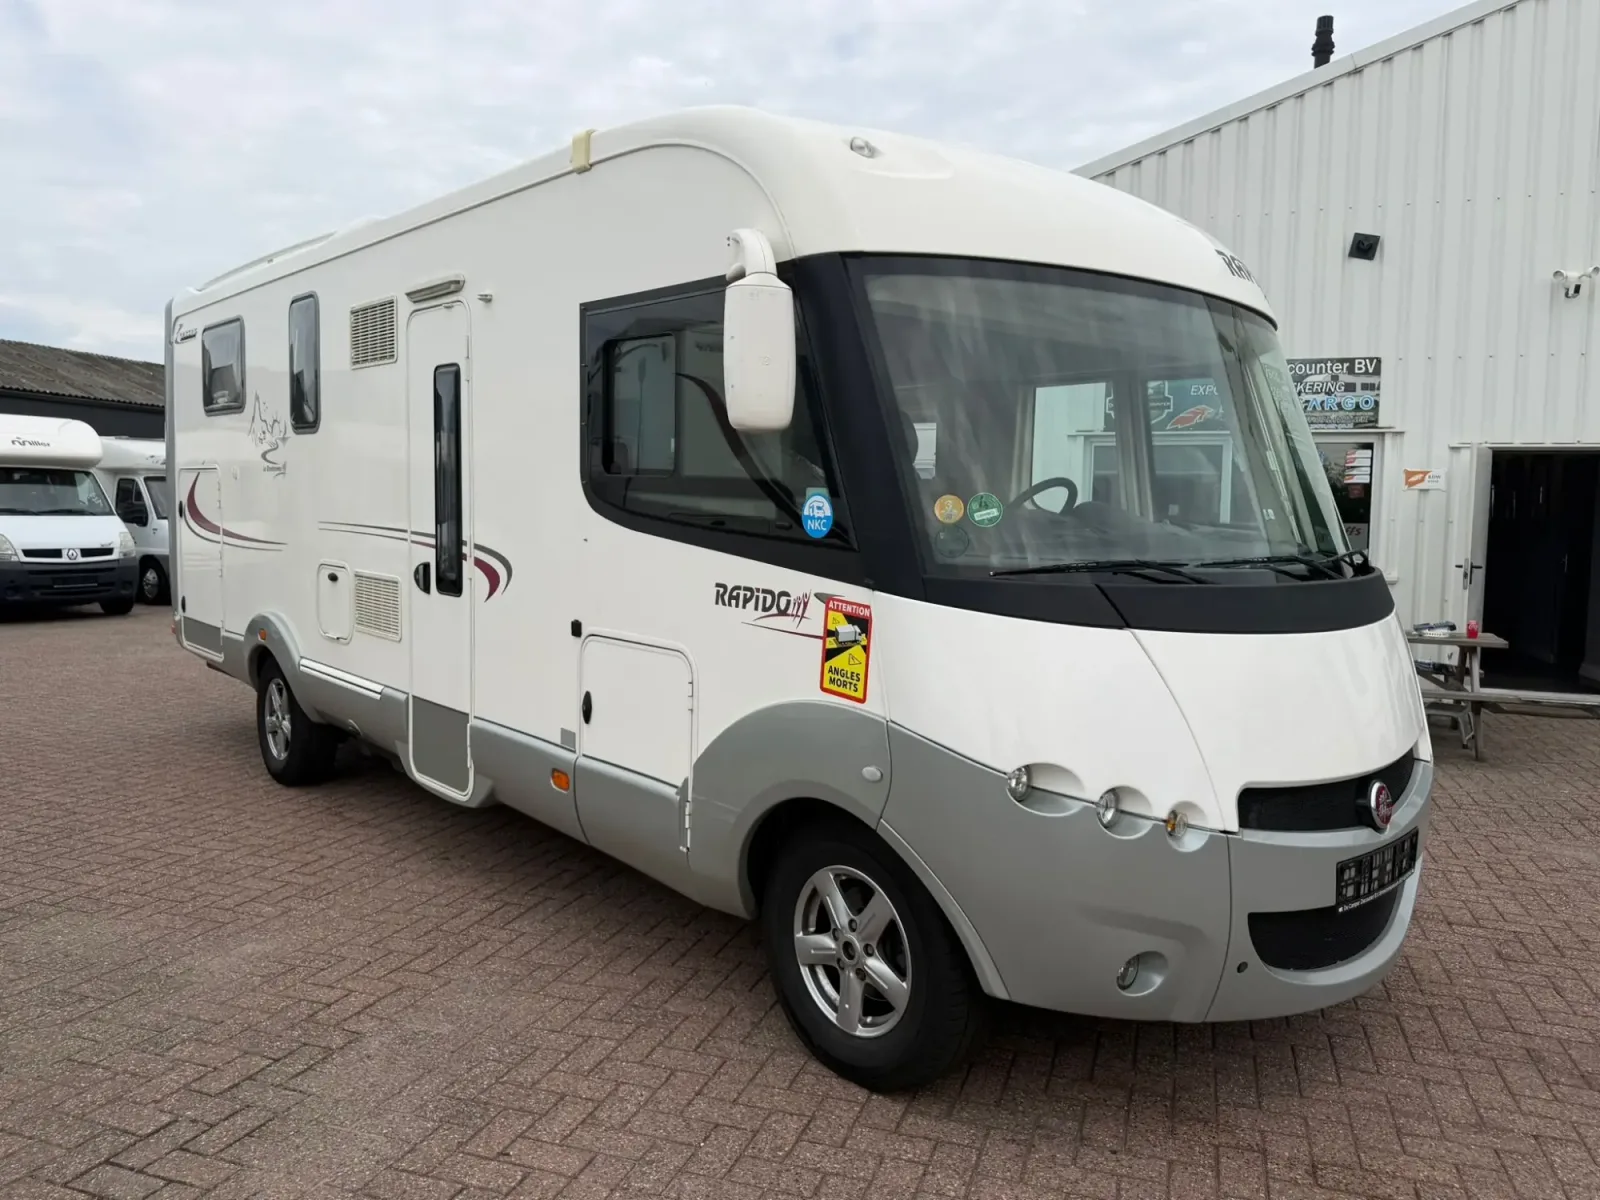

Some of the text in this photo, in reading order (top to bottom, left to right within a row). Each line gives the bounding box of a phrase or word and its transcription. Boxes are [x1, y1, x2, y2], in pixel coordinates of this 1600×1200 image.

[1354, 358, 1377, 374] BV
[1293, 380, 1346, 394] KERING
[807, 519, 827, 532] NKC
[827, 600, 871, 618] ATTENTION
[827, 665, 861, 683] ANGLES
[828, 677, 859, 693] MORTS
